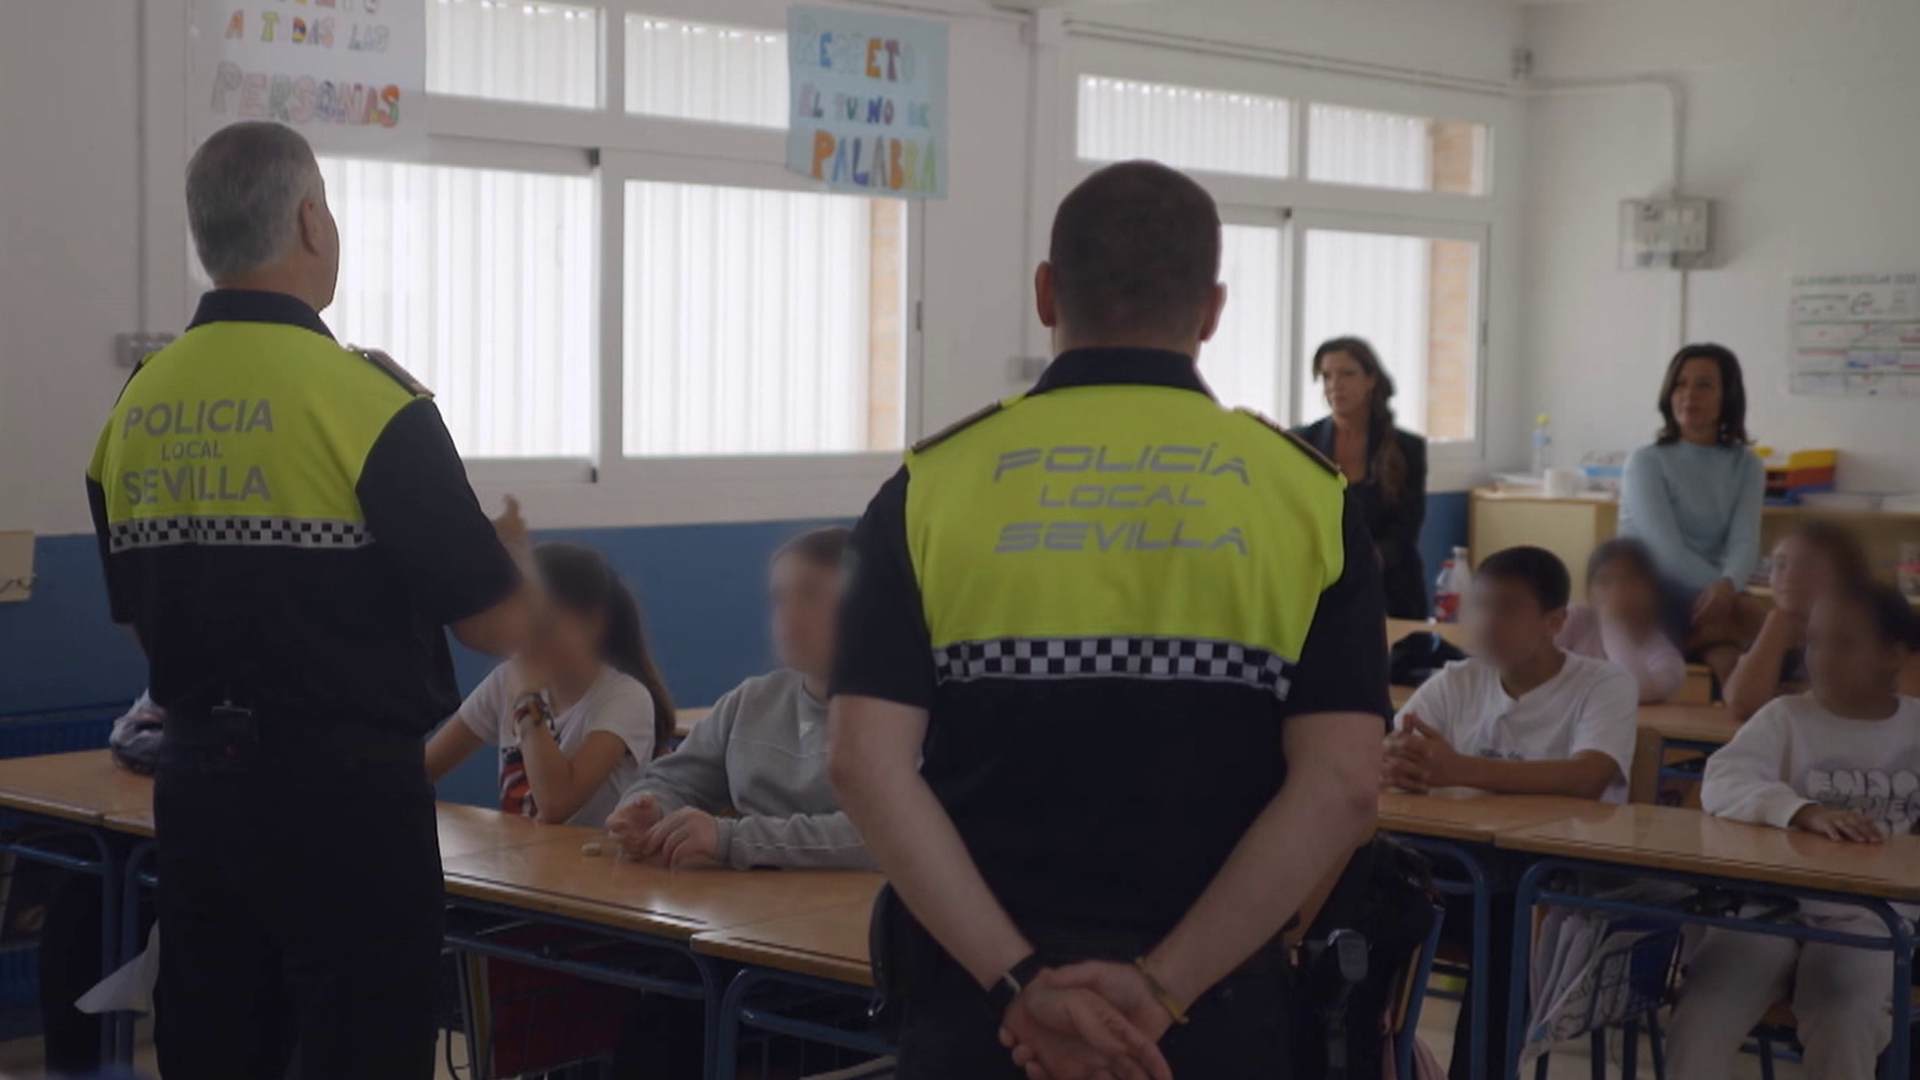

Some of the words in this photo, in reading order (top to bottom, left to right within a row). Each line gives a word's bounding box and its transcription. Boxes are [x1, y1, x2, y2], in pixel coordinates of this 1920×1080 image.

[225, 9, 244, 39] A
[210, 61, 401, 128] PERSONAS
[798, 83, 824, 118] EL
[835, 93, 895, 125] TUNO
[811, 130, 938, 192] PALABRA
[122, 398, 275, 440] POLICIA
[161, 441, 223, 461] LOCAL
[993, 442, 1250, 485] POLICÍA
[122, 465, 273, 506] SEVILLA
[1039, 484, 1206, 508] LOCAL
[994, 519, 1248, 556] SEVILLA
